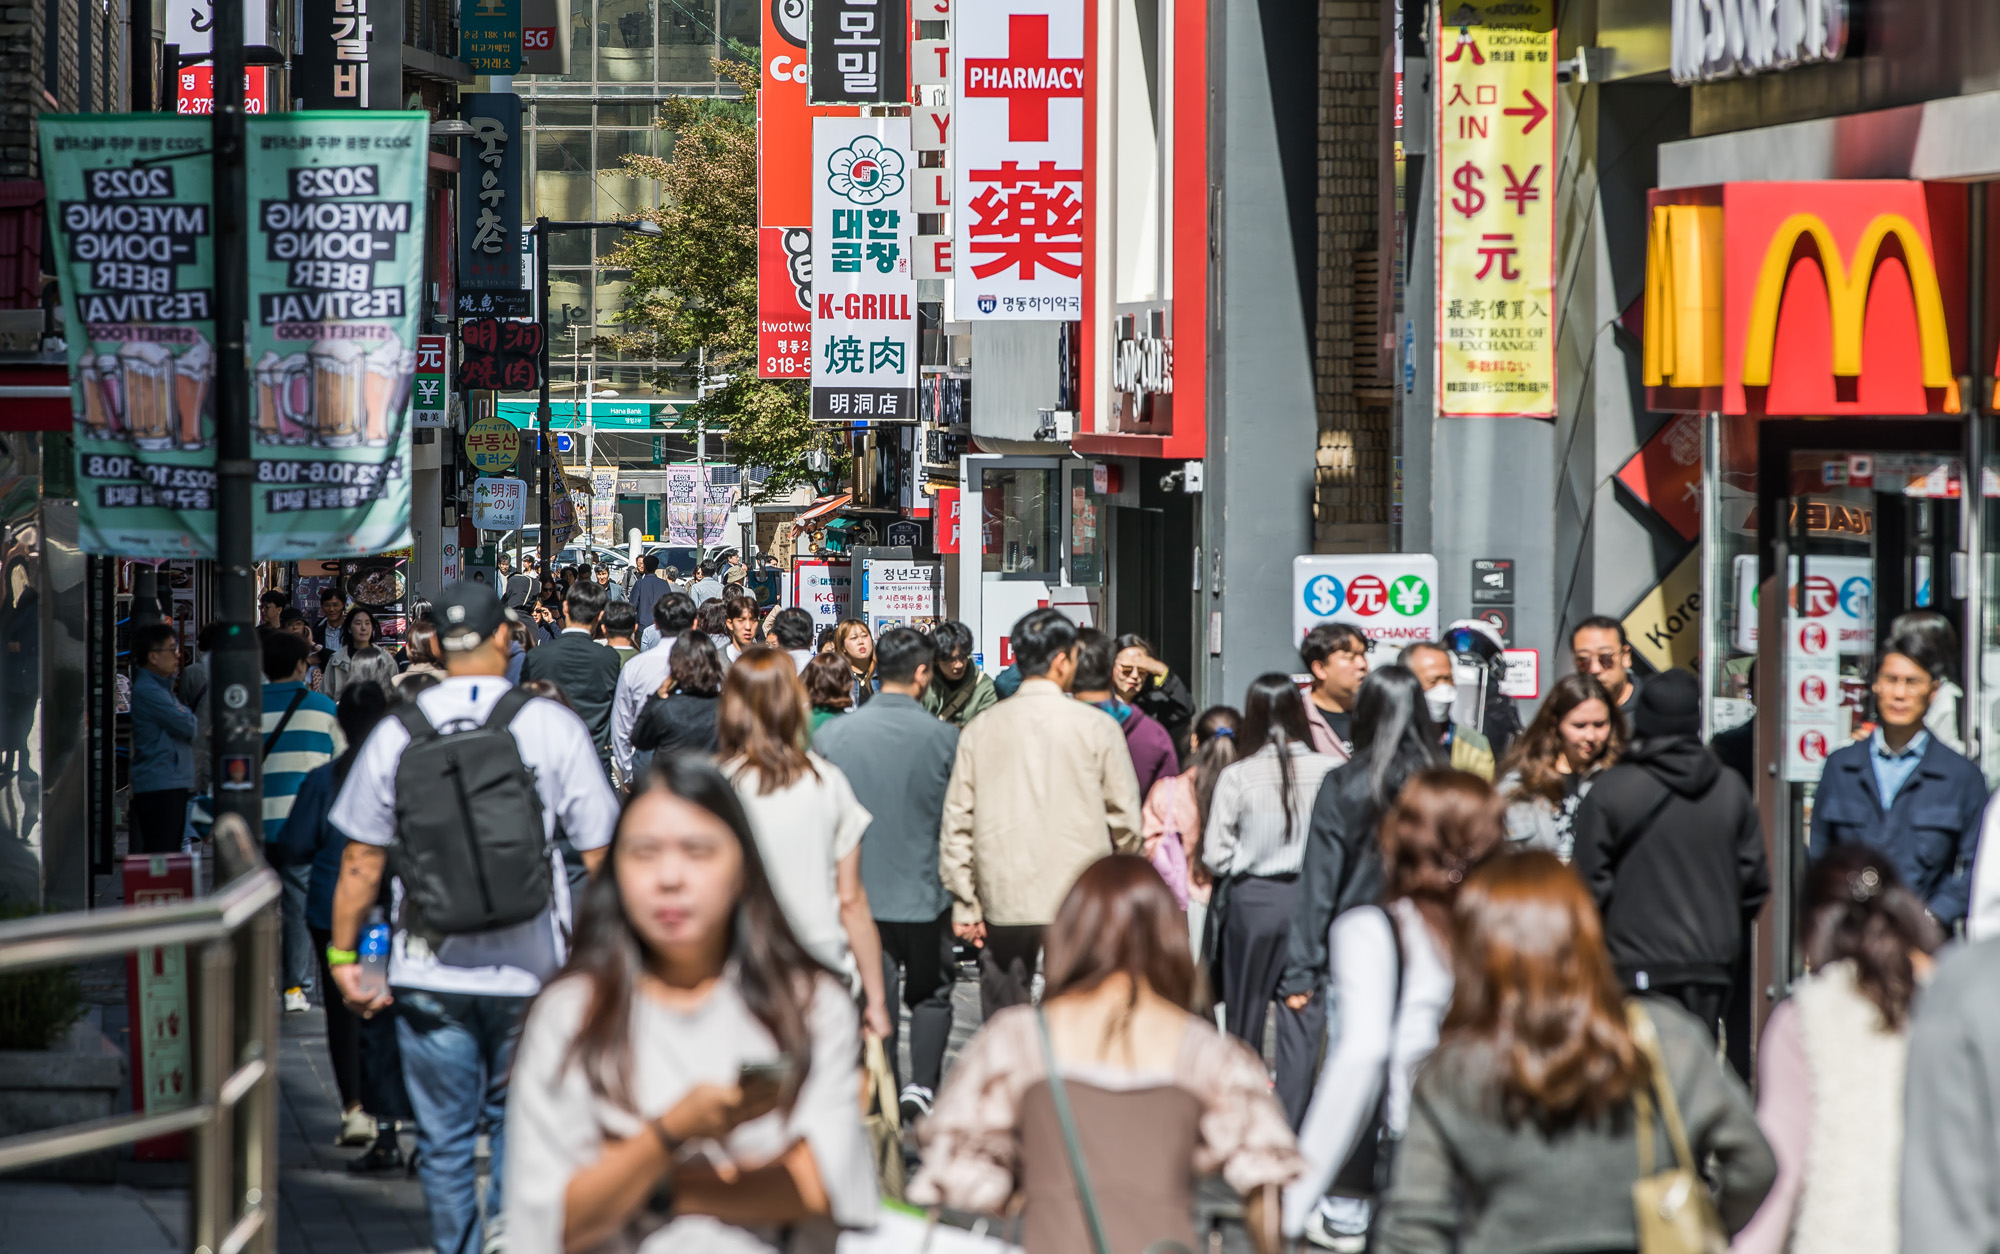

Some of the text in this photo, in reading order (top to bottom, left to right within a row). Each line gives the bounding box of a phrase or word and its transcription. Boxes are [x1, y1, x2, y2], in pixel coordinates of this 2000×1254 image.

[525, 30, 548, 47] 5G
[834, 0, 880, 93] 모밀
[1489, 35, 1548, 46] EXCHANGE
[970, 67, 1083, 90] PHARMACY
[1448, 84, 1497, 106] 入口
[1460, 116, 1488, 139] IN
[1452, 161, 1543, 219] $ ¥
[832, 209, 900, 240] 대한
[968, 161, 1083, 280] 藥
[832, 241, 900, 273] 곱창
[1475, 233, 1521, 281] 元
[818, 293, 912, 320] K-GRILL
[1002, 296, 1080, 312] 명동하이약국
[463, 318, 541, 355] 明洞
[1450, 327, 1546, 339] BEST RATE OF
[418, 343, 442, 368] 元
[823, 334, 905, 375] 焼肉
[1459, 340, 1538, 352] EXCHANGE
[418, 380, 439, 404] ¥
[829, 393, 898, 415] 明洞店
[467, 433, 518, 452] 부동산
[475, 453, 512, 466] 플러스
[491, 483, 520, 498] 明洞
[494, 499, 515, 511] のり
[892, 534, 917, 545] 18-1
[884, 568, 933, 581] 청년모밀
[814, 593, 849, 602] K-Grill
[1351, 578, 1385, 613] 元
